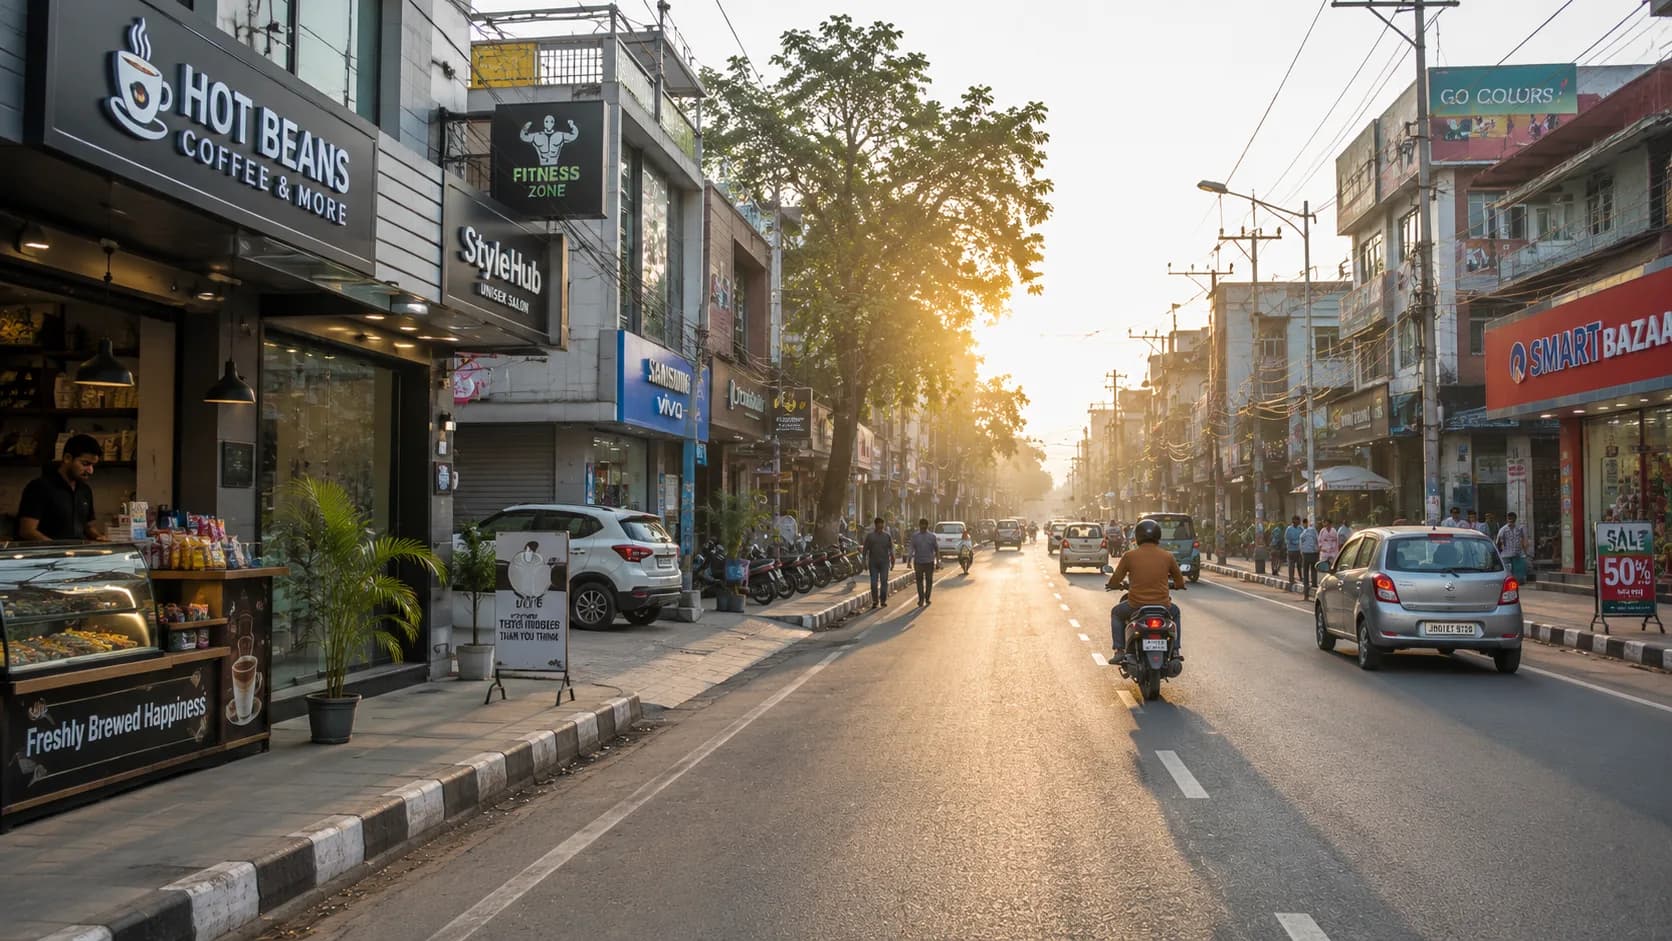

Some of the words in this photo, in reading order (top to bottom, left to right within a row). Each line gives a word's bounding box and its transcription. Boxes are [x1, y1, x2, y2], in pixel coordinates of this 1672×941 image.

[1440, 88, 1469, 105] GO
[180, 63, 253, 145] HOT
[260, 106, 350, 195] BEANS
[181, 129, 270, 192] COFFEE
[278, 175, 290, 200] &
[298, 183, 347, 226] MORE
[512, 166, 581, 183] FITNESS
[527, 183, 567, 199] ZONE
[461, 226, 542, 295] StyleHub
[1530, 321, 1602, 377] SMART
[657, 393, 683, 420] vivo
[1607, 526, 1649, 553] SALE
[26, 719, 85, 758] Freshly
[88, 704, 141, 742] Brewed
[144, 695, 206, 730] Happiness
